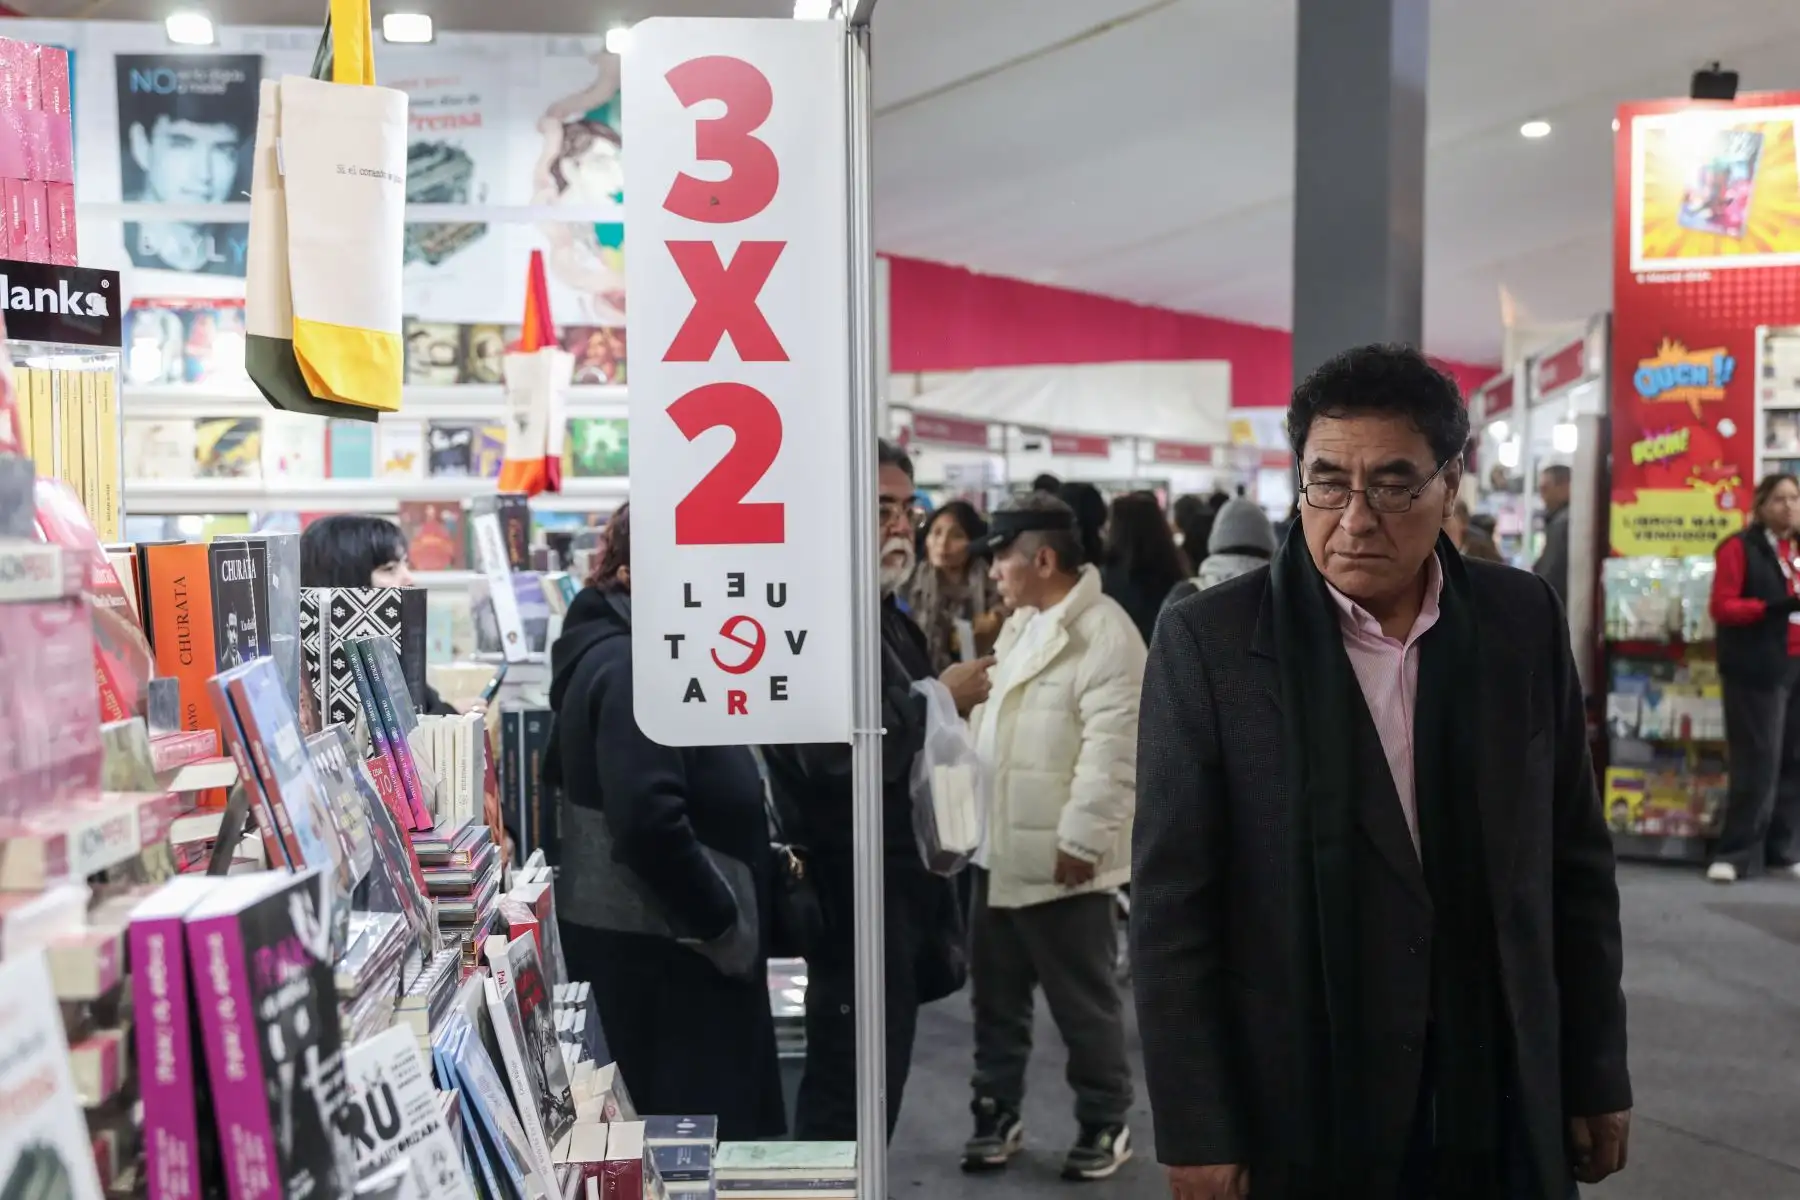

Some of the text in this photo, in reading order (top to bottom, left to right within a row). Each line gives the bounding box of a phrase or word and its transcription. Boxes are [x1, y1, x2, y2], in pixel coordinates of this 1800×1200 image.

[129, 67, 176, 94] NO
[0, 274, 109, 317] lanks
[222, 558, 257, 581] CHURATA
[173, 575, 193, 666] CHURATA
